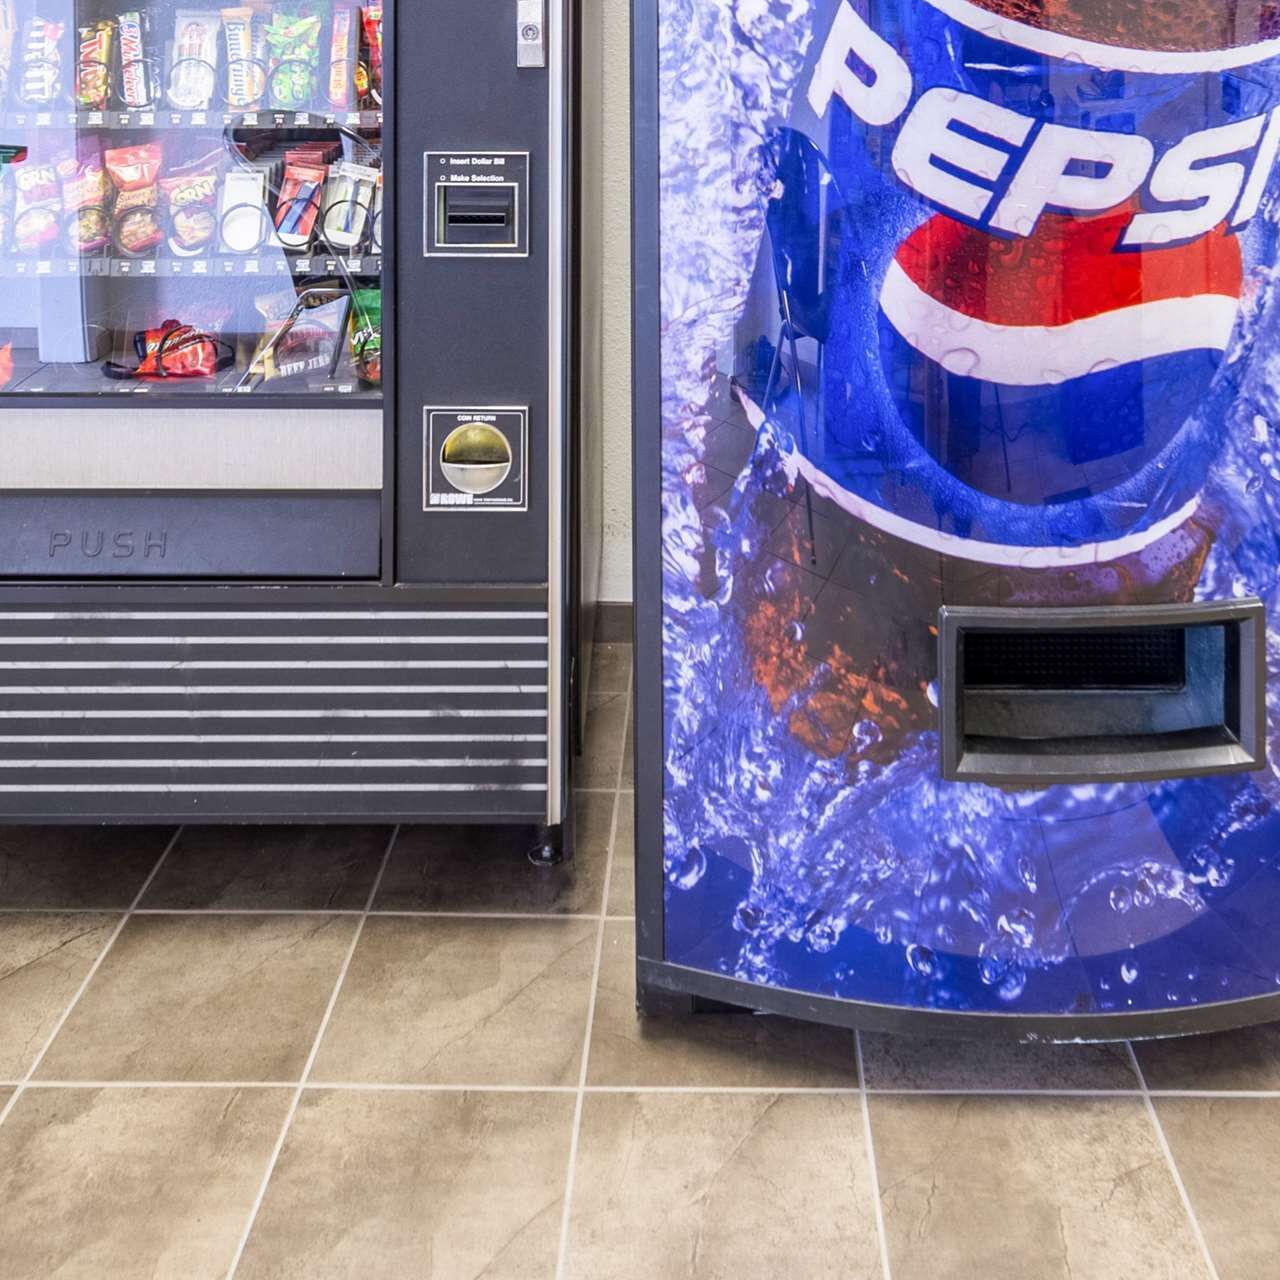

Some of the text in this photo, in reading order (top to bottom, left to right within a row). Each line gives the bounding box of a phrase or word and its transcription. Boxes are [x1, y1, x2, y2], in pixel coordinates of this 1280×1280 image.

[450, 174, 504, 182] Make Selection
[440, 493, 473, 504] ROWE
[48, 529, 168, 558] PUSH
